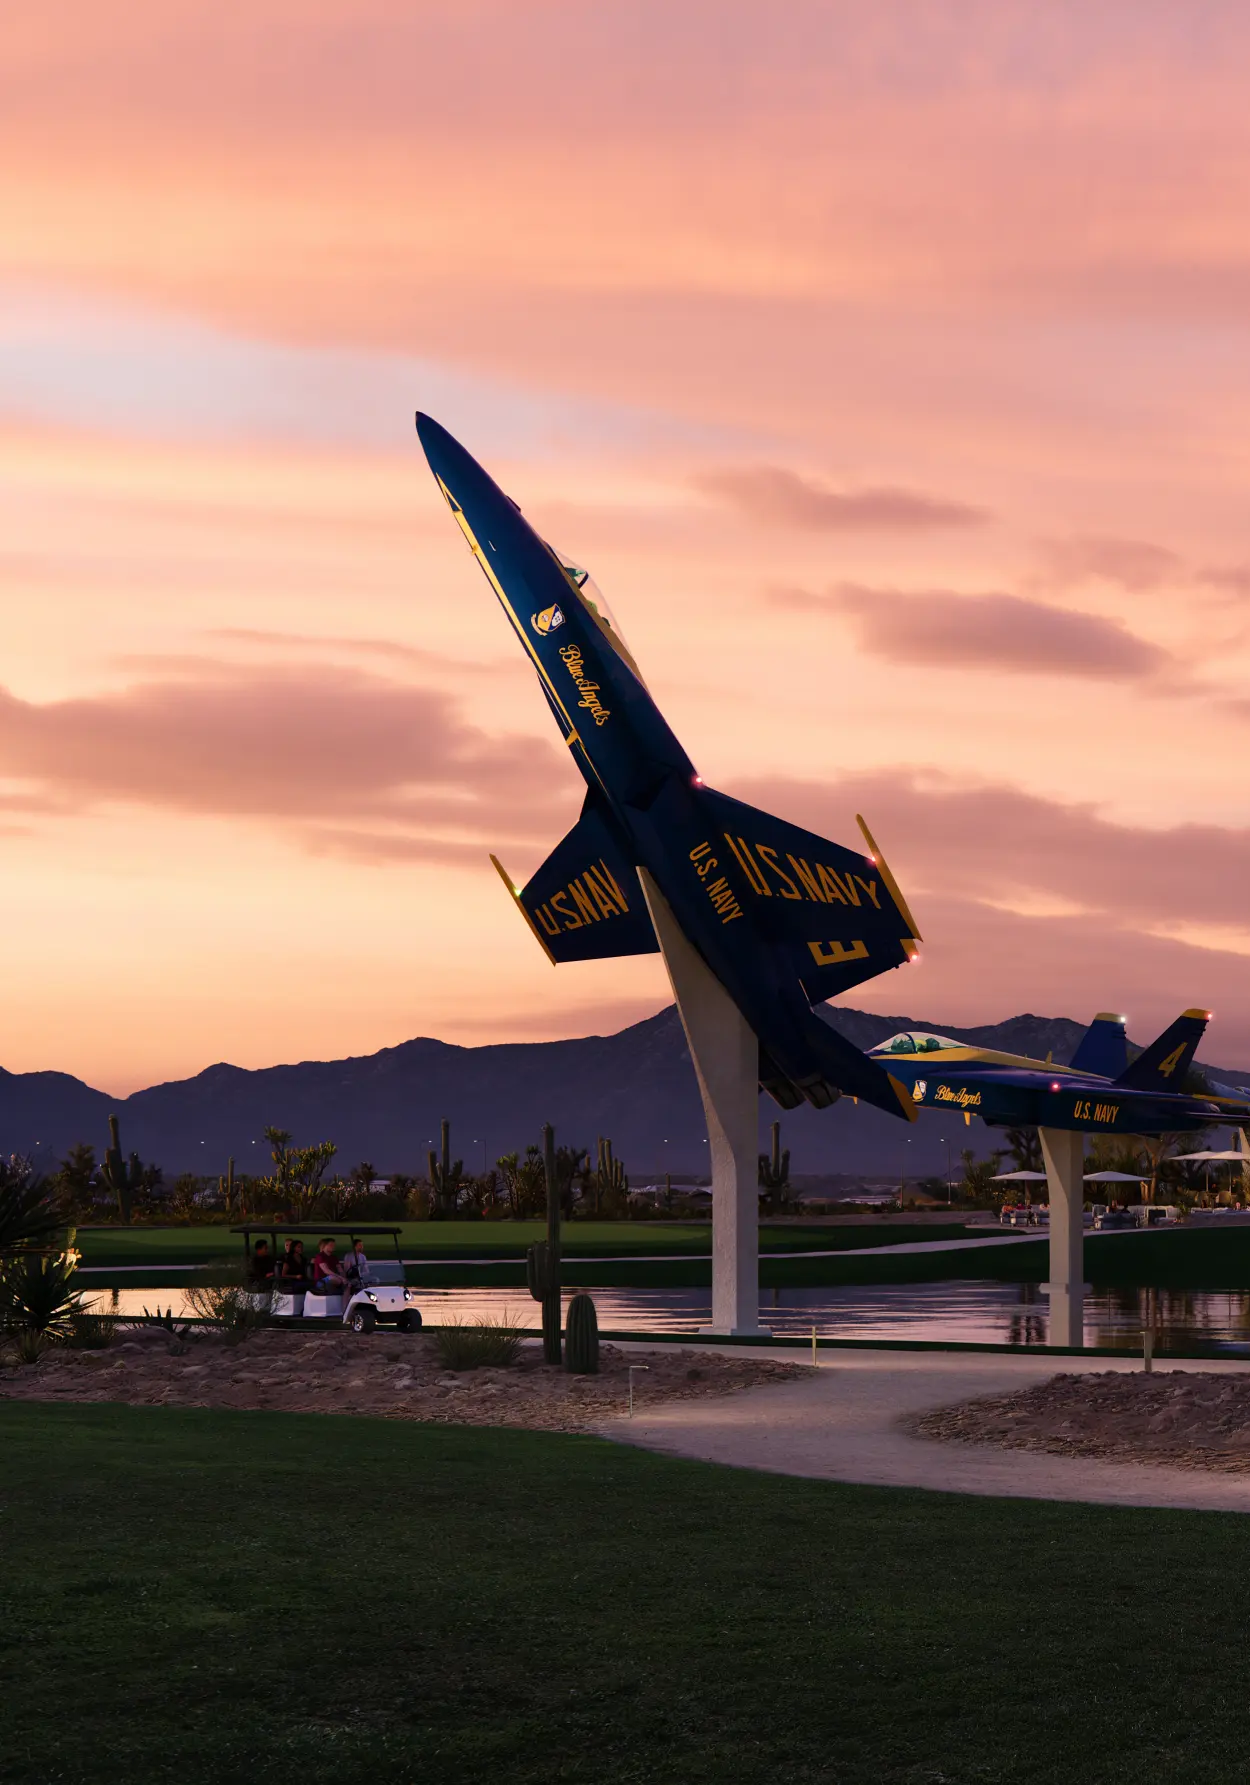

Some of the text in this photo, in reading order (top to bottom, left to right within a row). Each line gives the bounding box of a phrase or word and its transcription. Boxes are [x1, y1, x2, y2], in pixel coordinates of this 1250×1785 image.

[558, 644, 611, 727] Blue Angels
[689, 838, 744, 924] U.S. NAVY
[1158, 1042, 1188, 1078] 4
[934, 1084, 982, 1108] Blue Angels
[1073, 1100, 1120, 1124] U.S. NAVY
